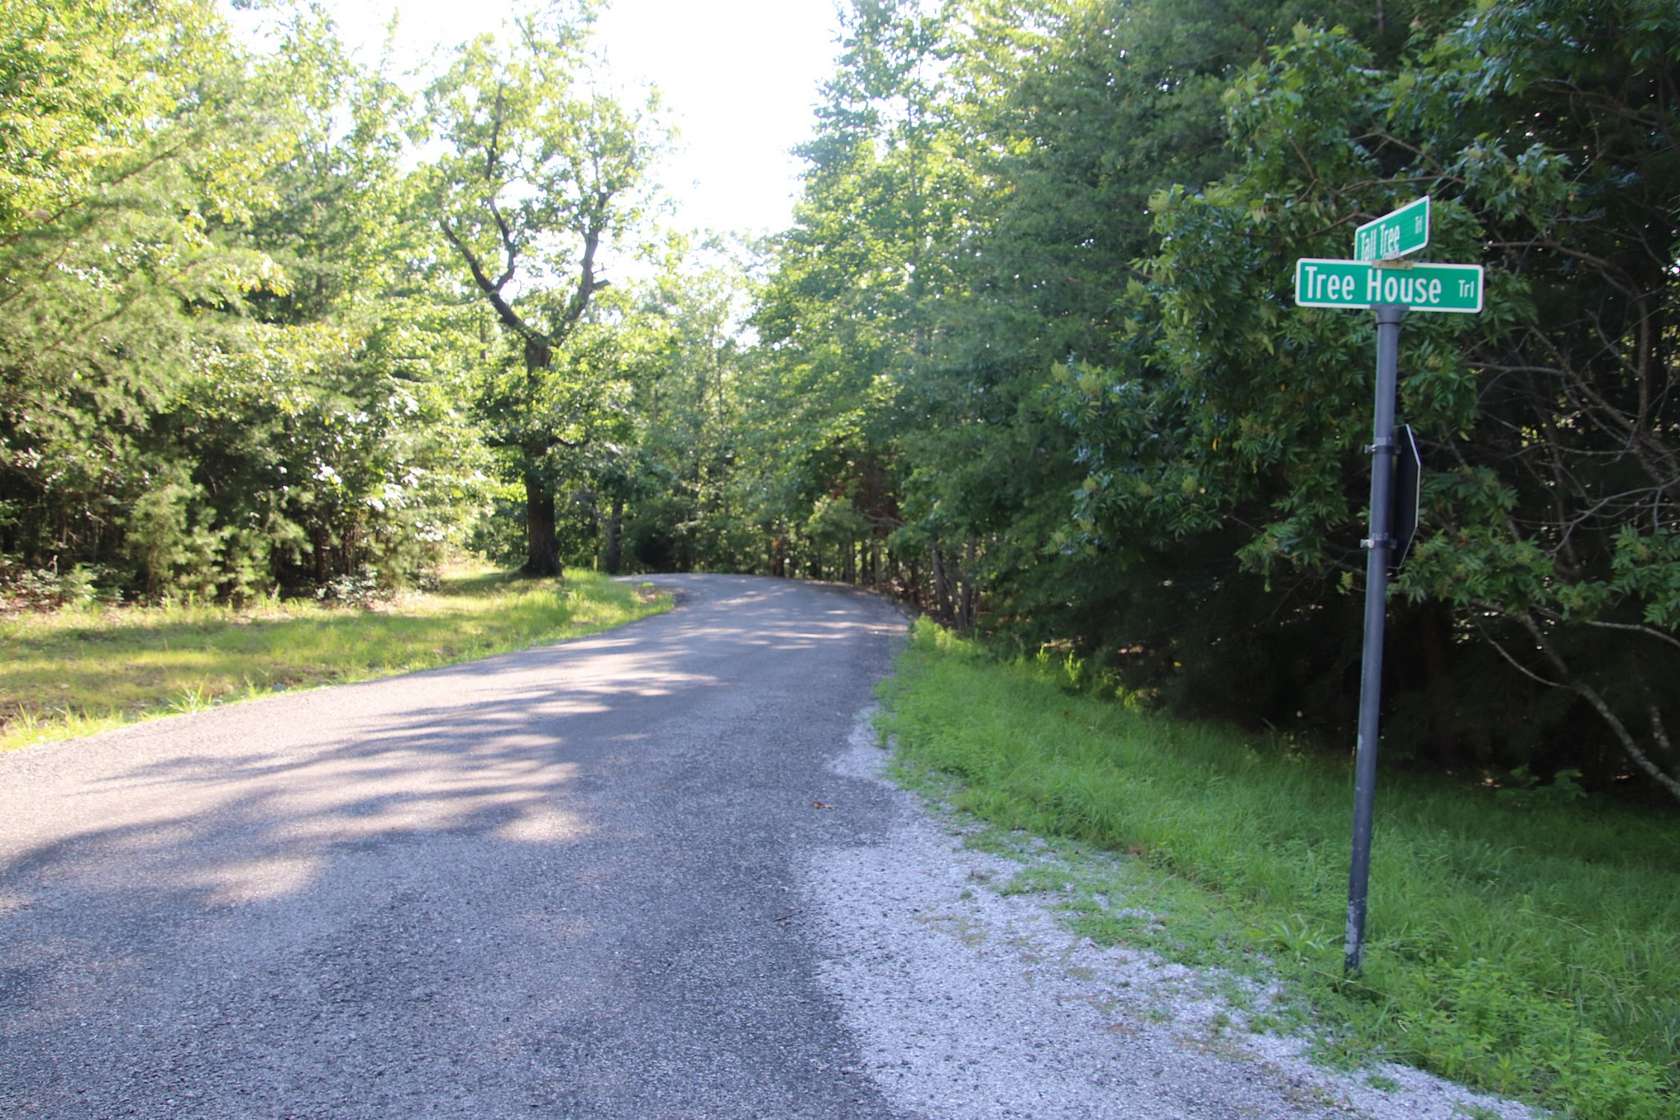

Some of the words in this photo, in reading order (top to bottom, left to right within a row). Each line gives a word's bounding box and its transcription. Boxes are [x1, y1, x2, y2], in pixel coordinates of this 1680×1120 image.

[1360, 230, 1377, 262] Tall
[1379, 223, 1400, 255] Tree
[1304, 265, 1355, 300] Tree
[1366, 268, 1442, 304] House
[1458, 279, 1475, 298] Trl
